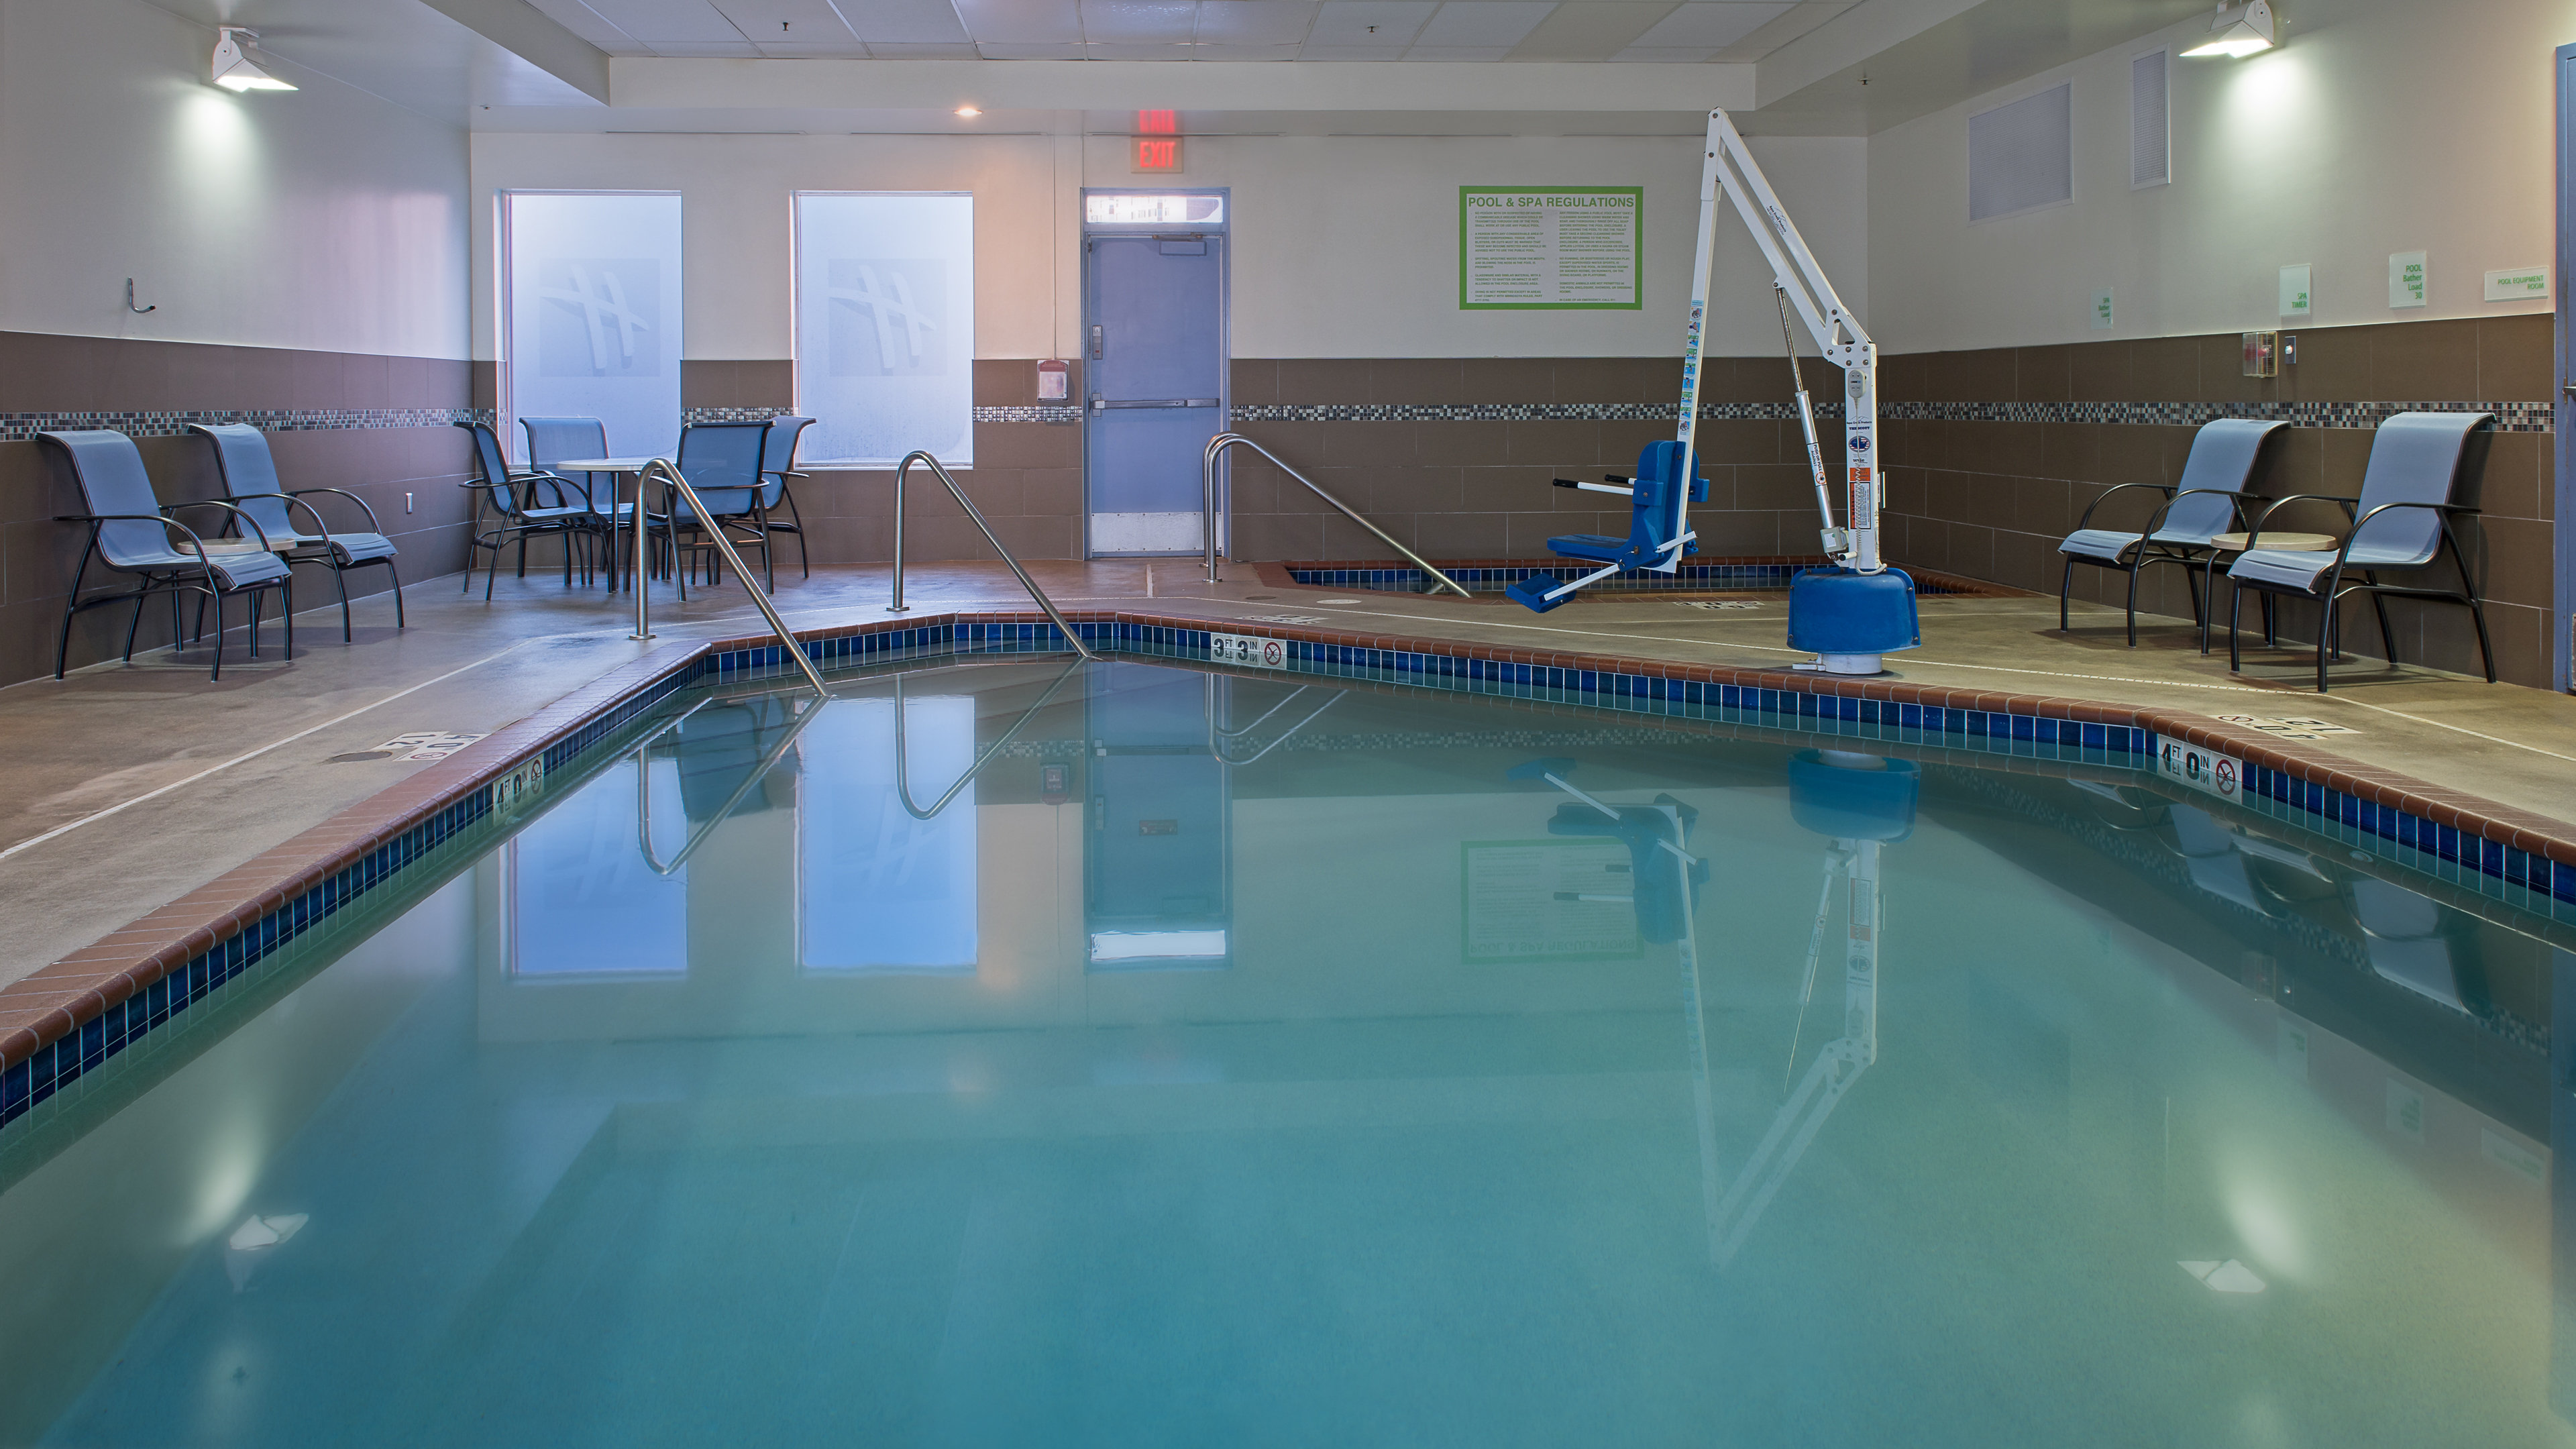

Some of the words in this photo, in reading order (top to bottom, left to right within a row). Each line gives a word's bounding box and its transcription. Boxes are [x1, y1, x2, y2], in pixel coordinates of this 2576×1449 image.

[1139, 141, 1175, 168] EXIT
[1468, 197, 1503, 207] POOL
[1506, 197, 1514, 207] &
[1518, 197, 1542, 207] SPA
[1546, 197, 1633, 207] REGULATIONS
[2406, 264, 2422, 272] POOL
[2403, 274, 2422, 282] Bather
[2513, 275, 2544, 284] EQUIPMENT
[2408, 282, 2422, 290] Load
[1214, 639, 1224, 649] 3
[1226, 639, 1232, 647] FT
[1238, 641, 1248, 652] 3
[1250, 641, 1257, 649] IN
[2173, 745, 2180, 758] FT
[2200, 755, 2209, 769] IN
[504, 779, 511, 793] FT
[522, 769, 527, 783] IN
